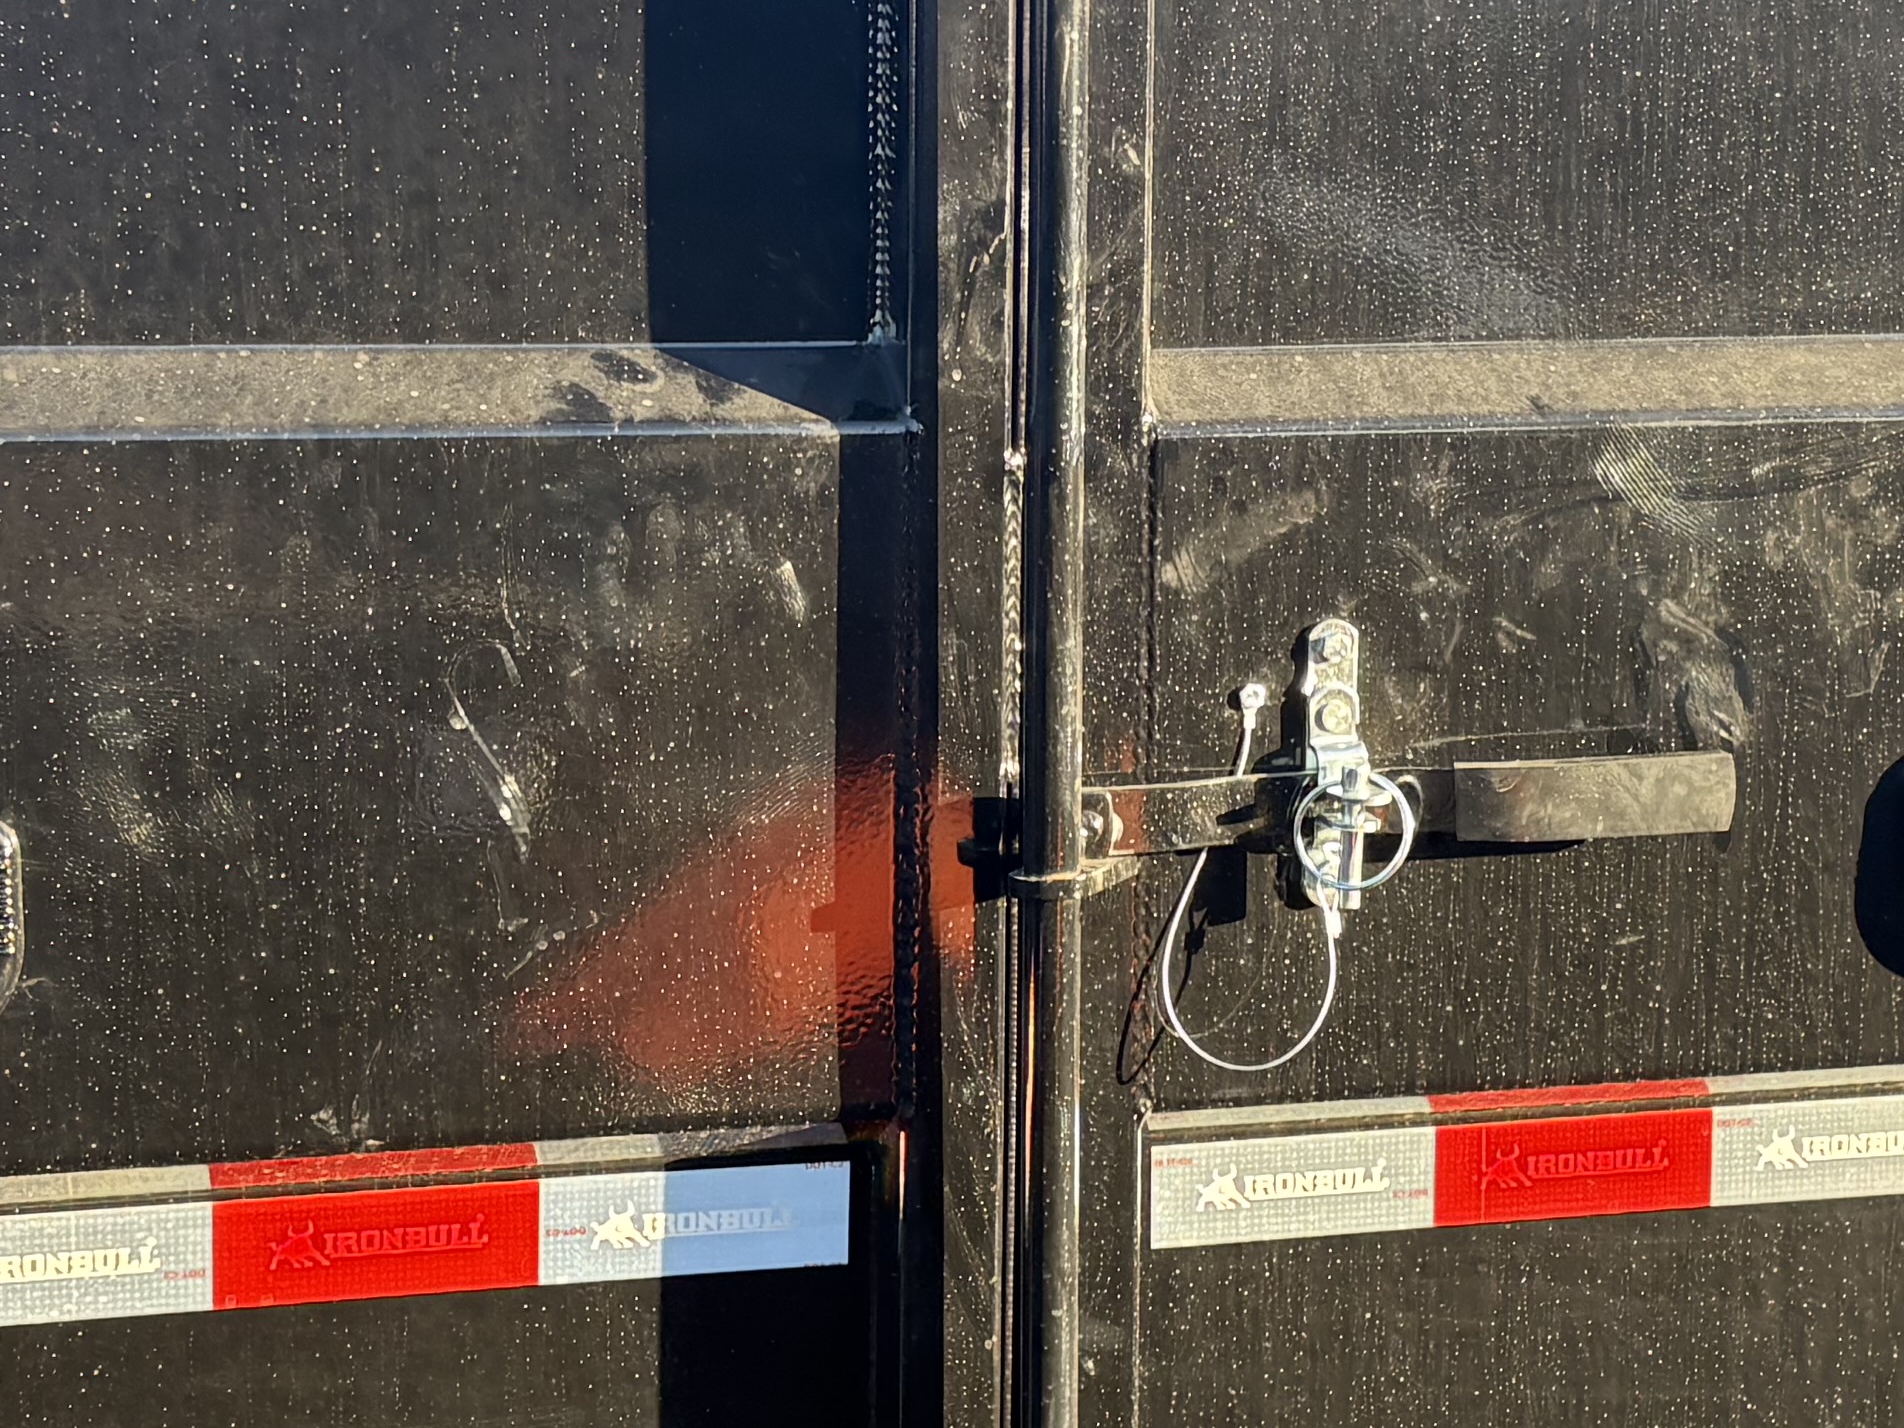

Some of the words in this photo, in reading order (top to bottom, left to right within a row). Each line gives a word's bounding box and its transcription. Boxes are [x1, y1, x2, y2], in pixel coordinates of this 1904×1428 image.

[1243, 1158, 1390, 1201] IRONBULL
[1526, 1139, 1669, 1179] IRONBULL
[324, 1213, 489, 1258] IRONBULL
